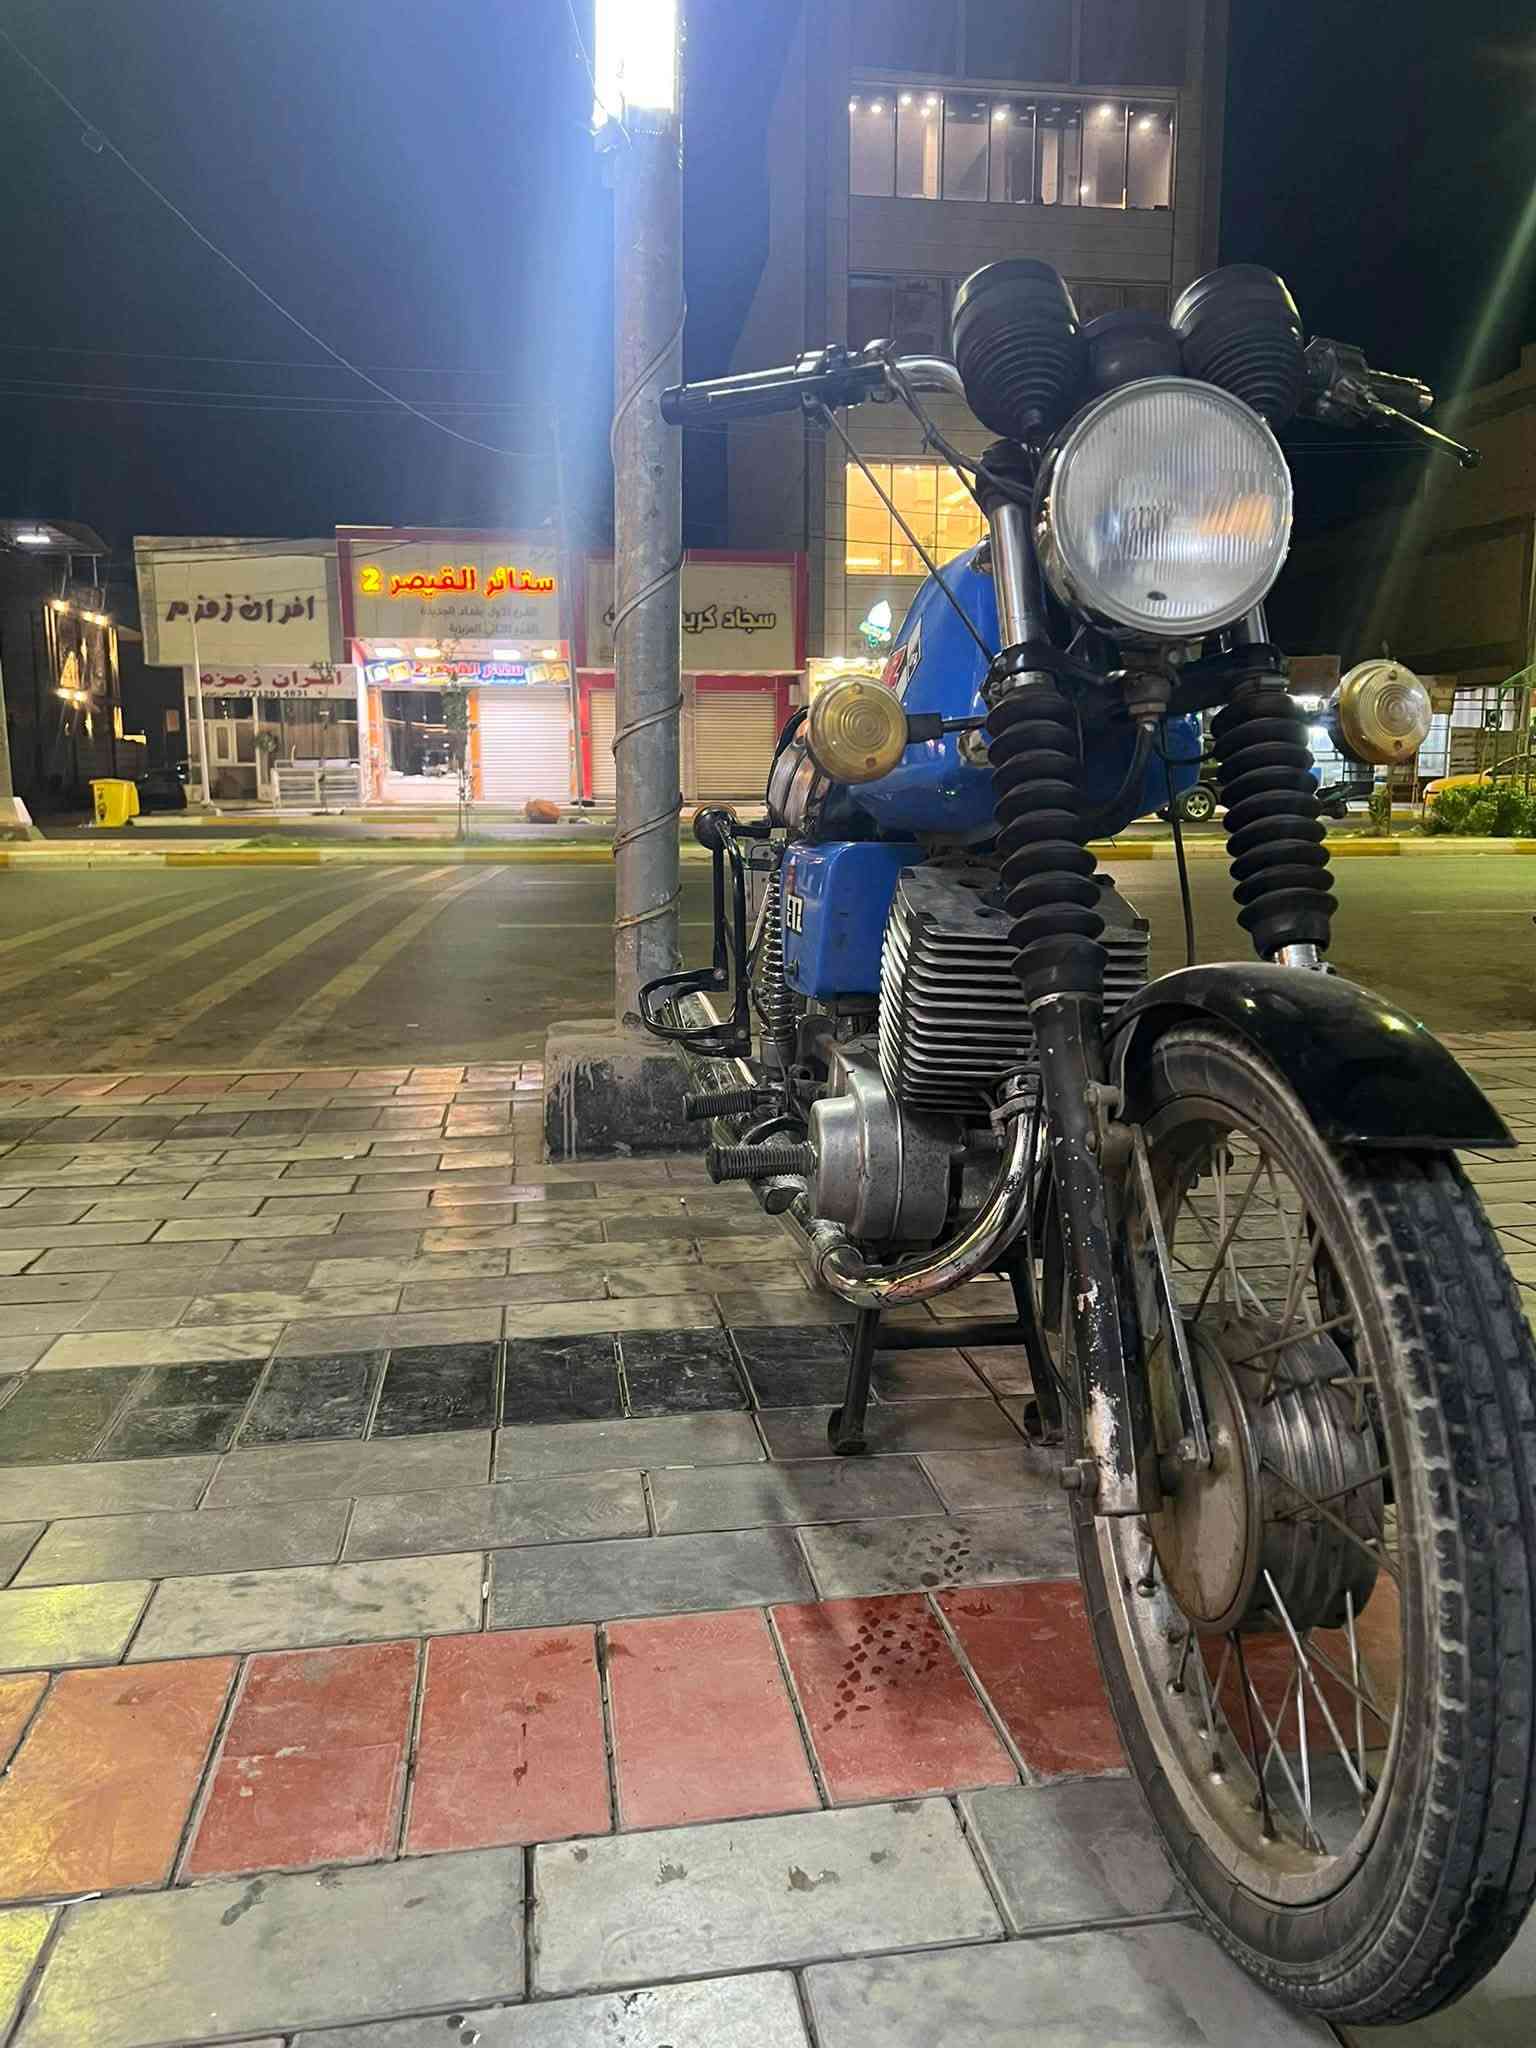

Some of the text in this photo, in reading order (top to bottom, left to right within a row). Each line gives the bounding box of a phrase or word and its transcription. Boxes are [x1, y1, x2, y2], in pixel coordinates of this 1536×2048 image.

[361, 563, 555, 600] ستائر القيصر 2
[722, 604, 777, 634] سجاد
[200, 669, 262, 688] زمزم
